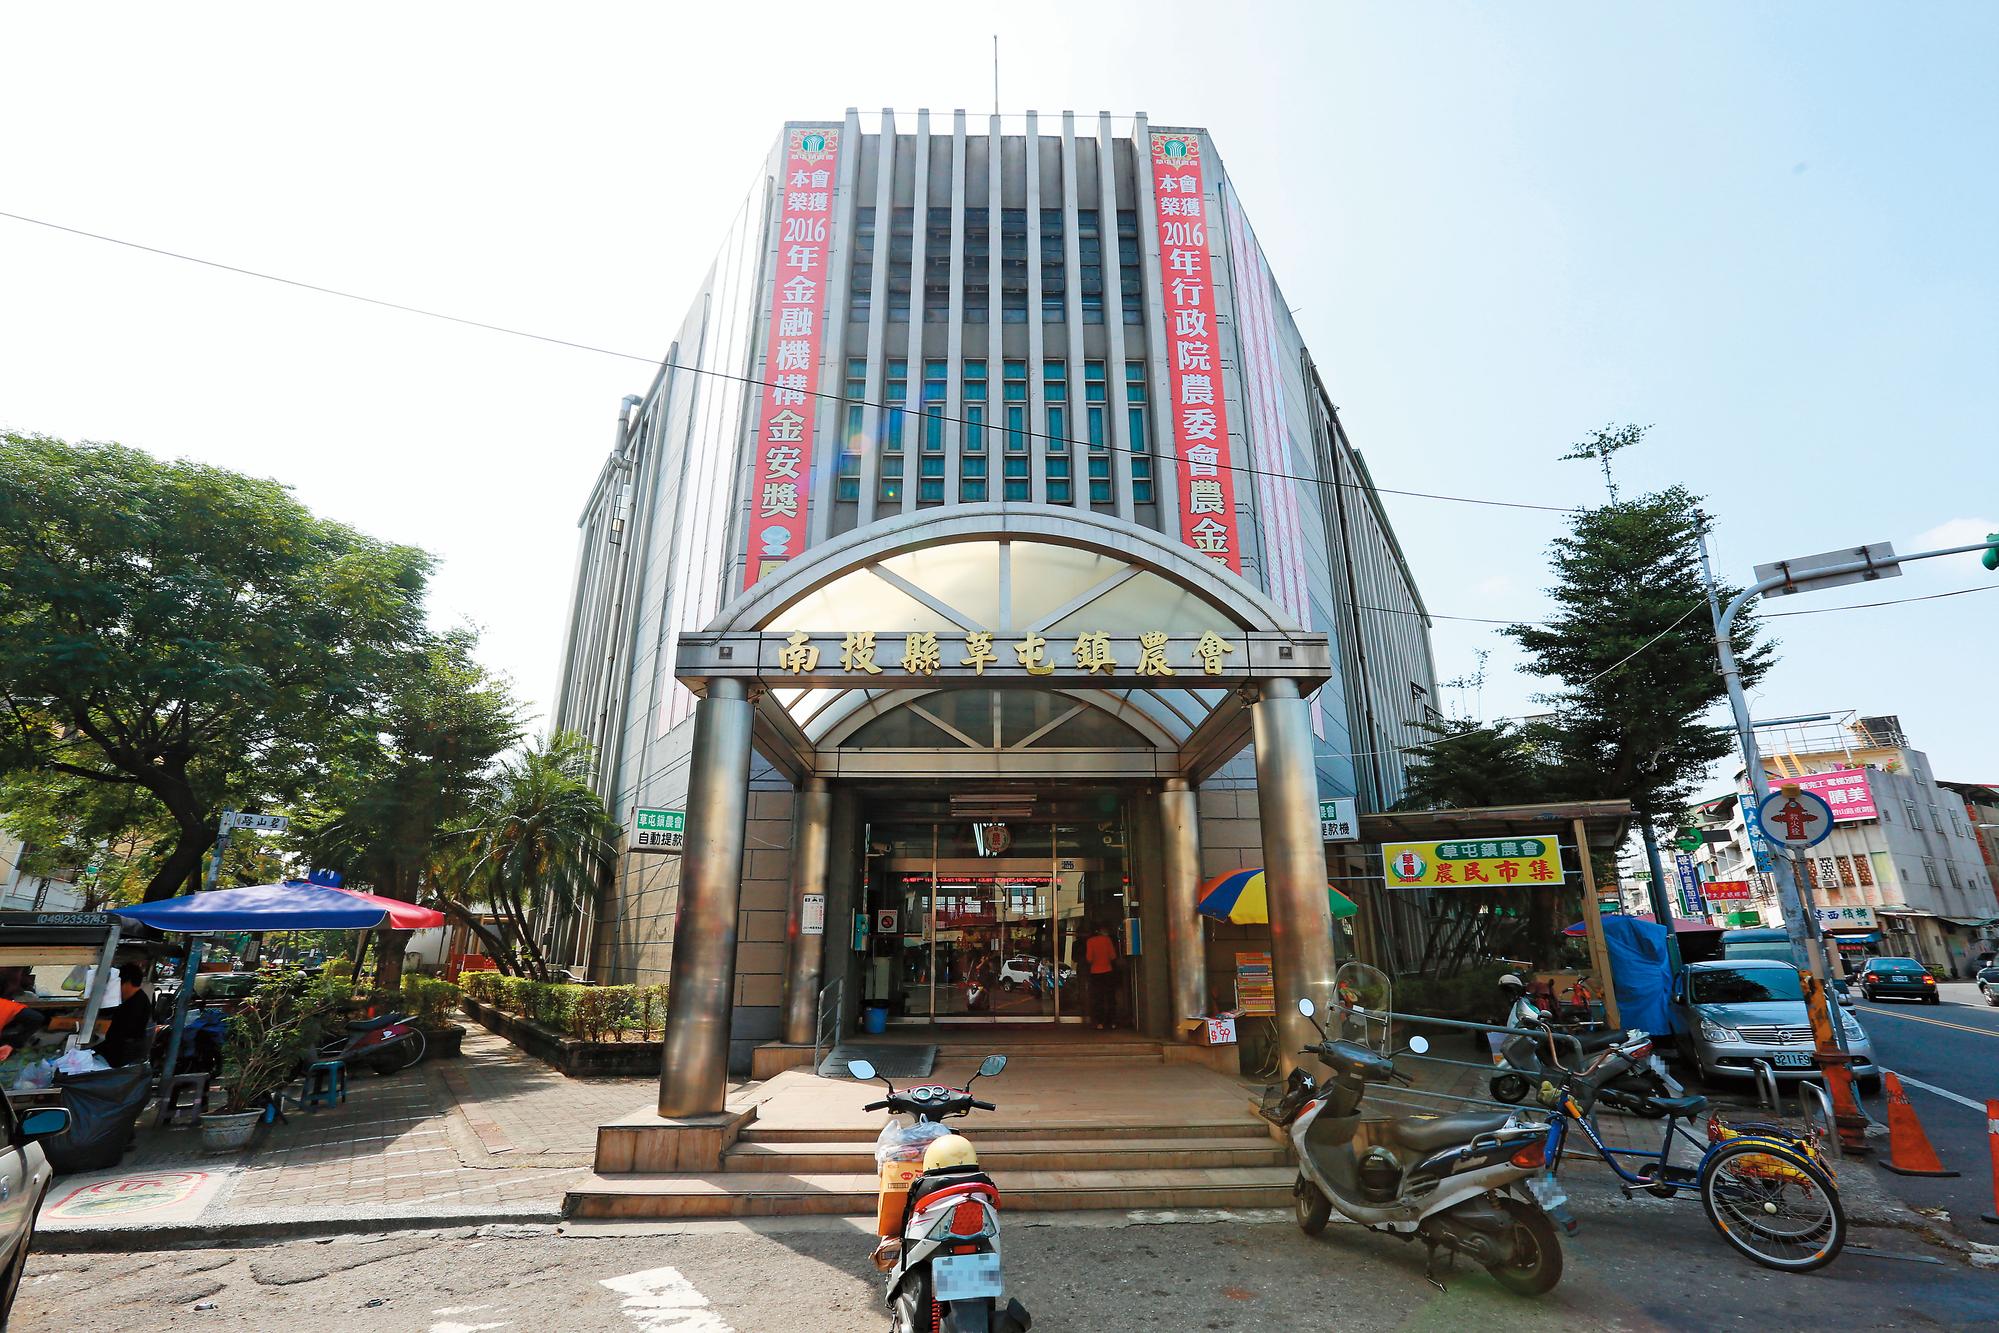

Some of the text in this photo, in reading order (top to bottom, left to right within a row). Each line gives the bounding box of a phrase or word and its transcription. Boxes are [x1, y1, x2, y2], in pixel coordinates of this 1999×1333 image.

[790, 169, 830, 188] 本會
[1159, 174, 1197, 193] 本會
[788, 192, 828, 212] 榮獲
[1161, 197, 1200, 217] 榮獲
[784, 217, 826, 242] 2016
[1163, 222, 1204, 247] 2016
[1169, 248, 1230, 567] 年行政院農委會農金
[777, 629, 1235, 677] 南投縣草屯鎮農會
[639, 813, 683, 829] 草屯鎮農會
[1441, 840, 1538, 859] 草屯鎮農會
[1434, 859, 1554, 884] 農民市集
